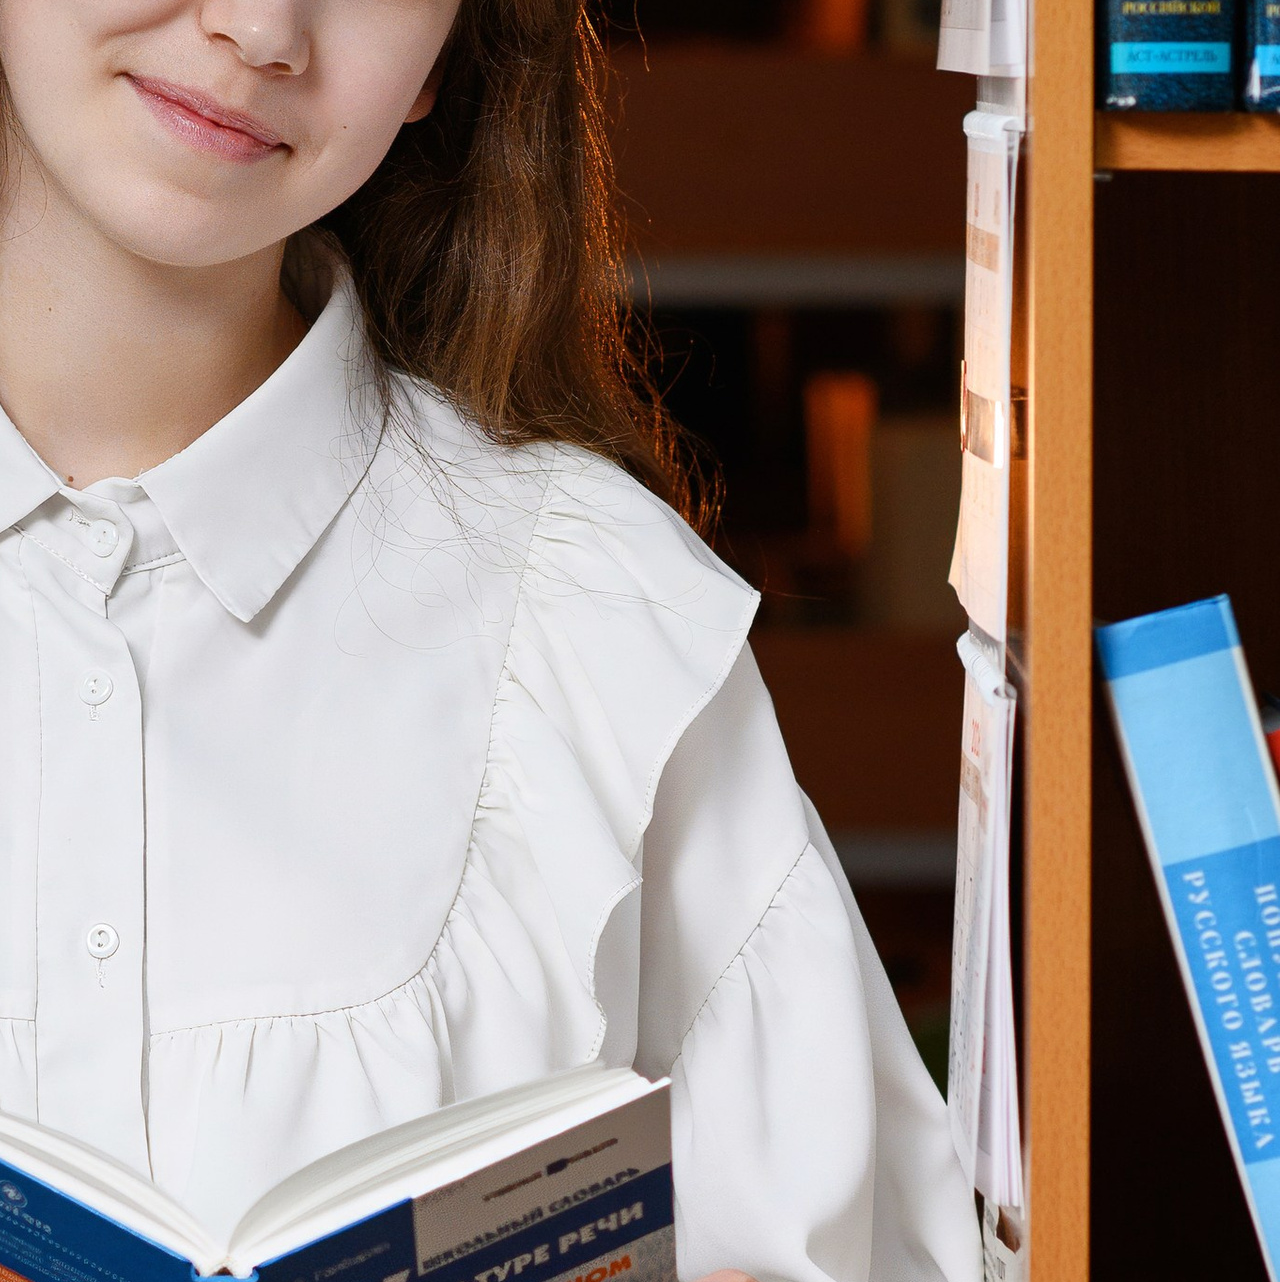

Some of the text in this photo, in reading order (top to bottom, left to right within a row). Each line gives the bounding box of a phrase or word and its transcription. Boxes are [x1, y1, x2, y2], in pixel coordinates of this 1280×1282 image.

[1183, 870, 1274, 1149] РУССКОГО ЯЗЫКА
[1233, 930, 1280, 1073] СЛОВАРЬ
[549, 1167, 640, 1212] СЛОВАРЬ
[558, 1201, 644, 1254] РЕЧИ
